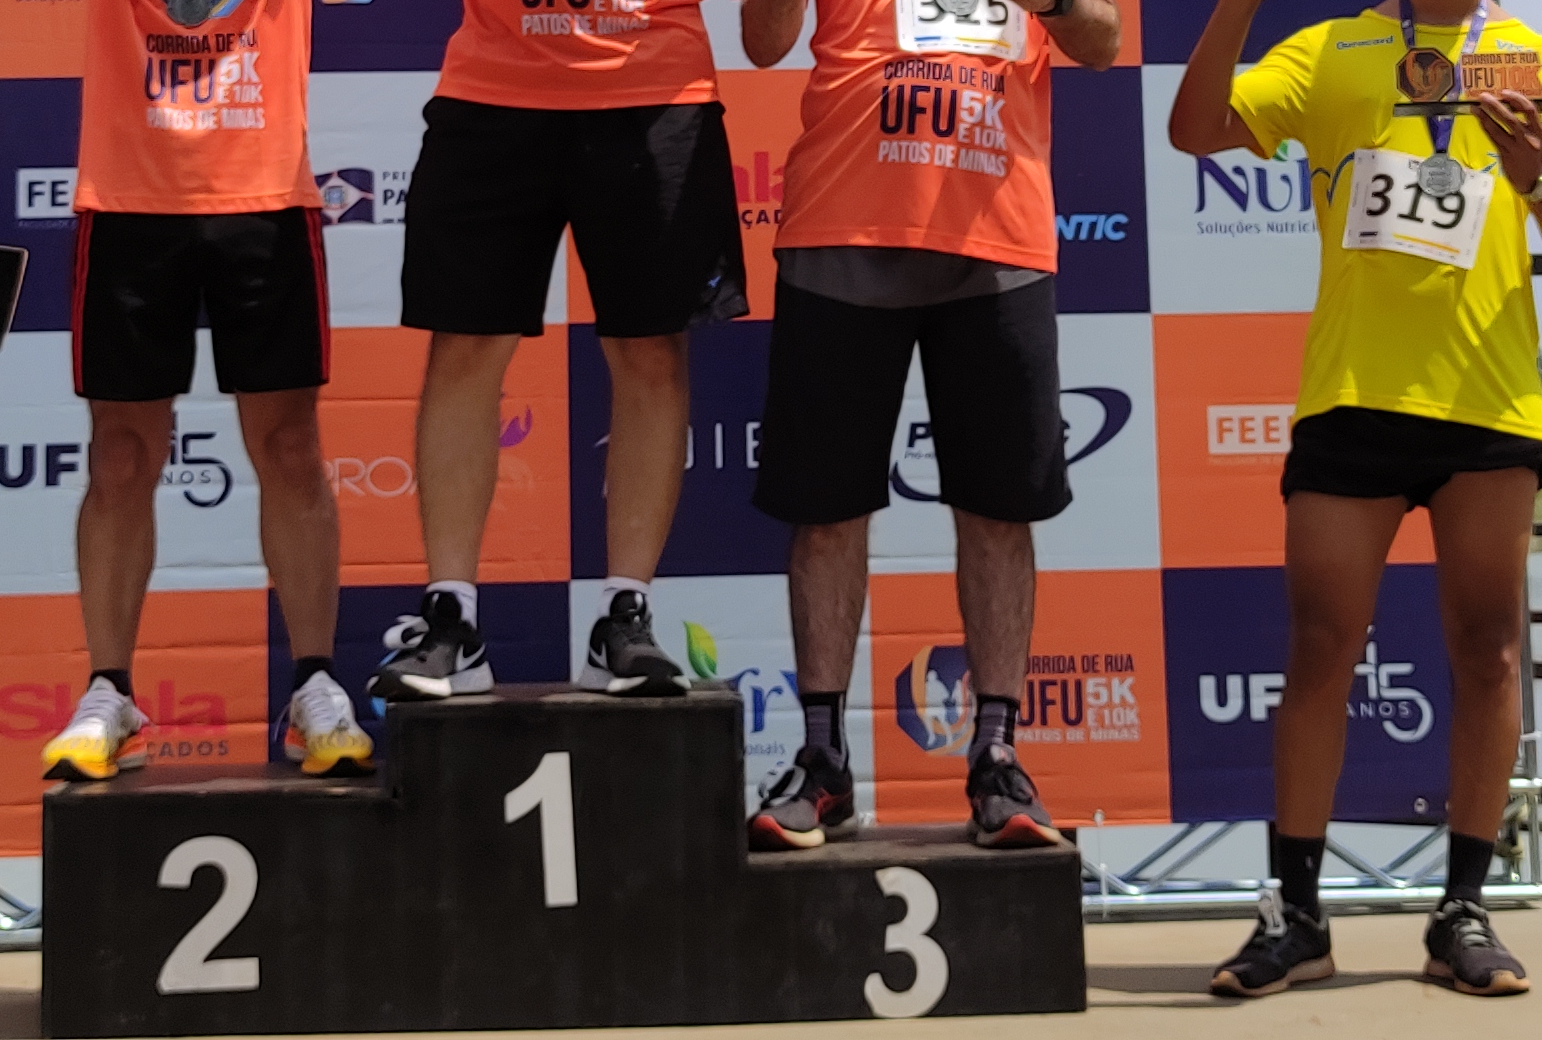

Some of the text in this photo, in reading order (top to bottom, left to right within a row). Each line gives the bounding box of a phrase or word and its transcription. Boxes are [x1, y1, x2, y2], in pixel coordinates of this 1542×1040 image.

[521, 13, 572, 36] PATOS
[147, 33, 235, 54] CORRIDA DE
[145, 57, 216, 103] UFU
[884, 60, 1005, 95] CORRIDA DE RUA
[1462, 65, 1542, 90] UFU 10K
[880, 84, 1005, 137] UFU 5K
[878, 139, 1007, 177] PATOS DE MINAS
[1366, 173, 1466, 230] 319
[1197, 221, 1317, 237] Soluções Nutrici
[1216, 415, 1292, 444] FEE
[160, 469, 211, 485] NOS
[1081, 654, 1135, 673] DE RUA
[1086, 677, 1136, 706] 5K
[1199, 673, 1287, 722] UF
[146, 740, 229, 761] ÇADOS
[504, 751, 578, 908] 1
[156, 835, 260, 996] 2
[863, 866, 950, 1018] 3
